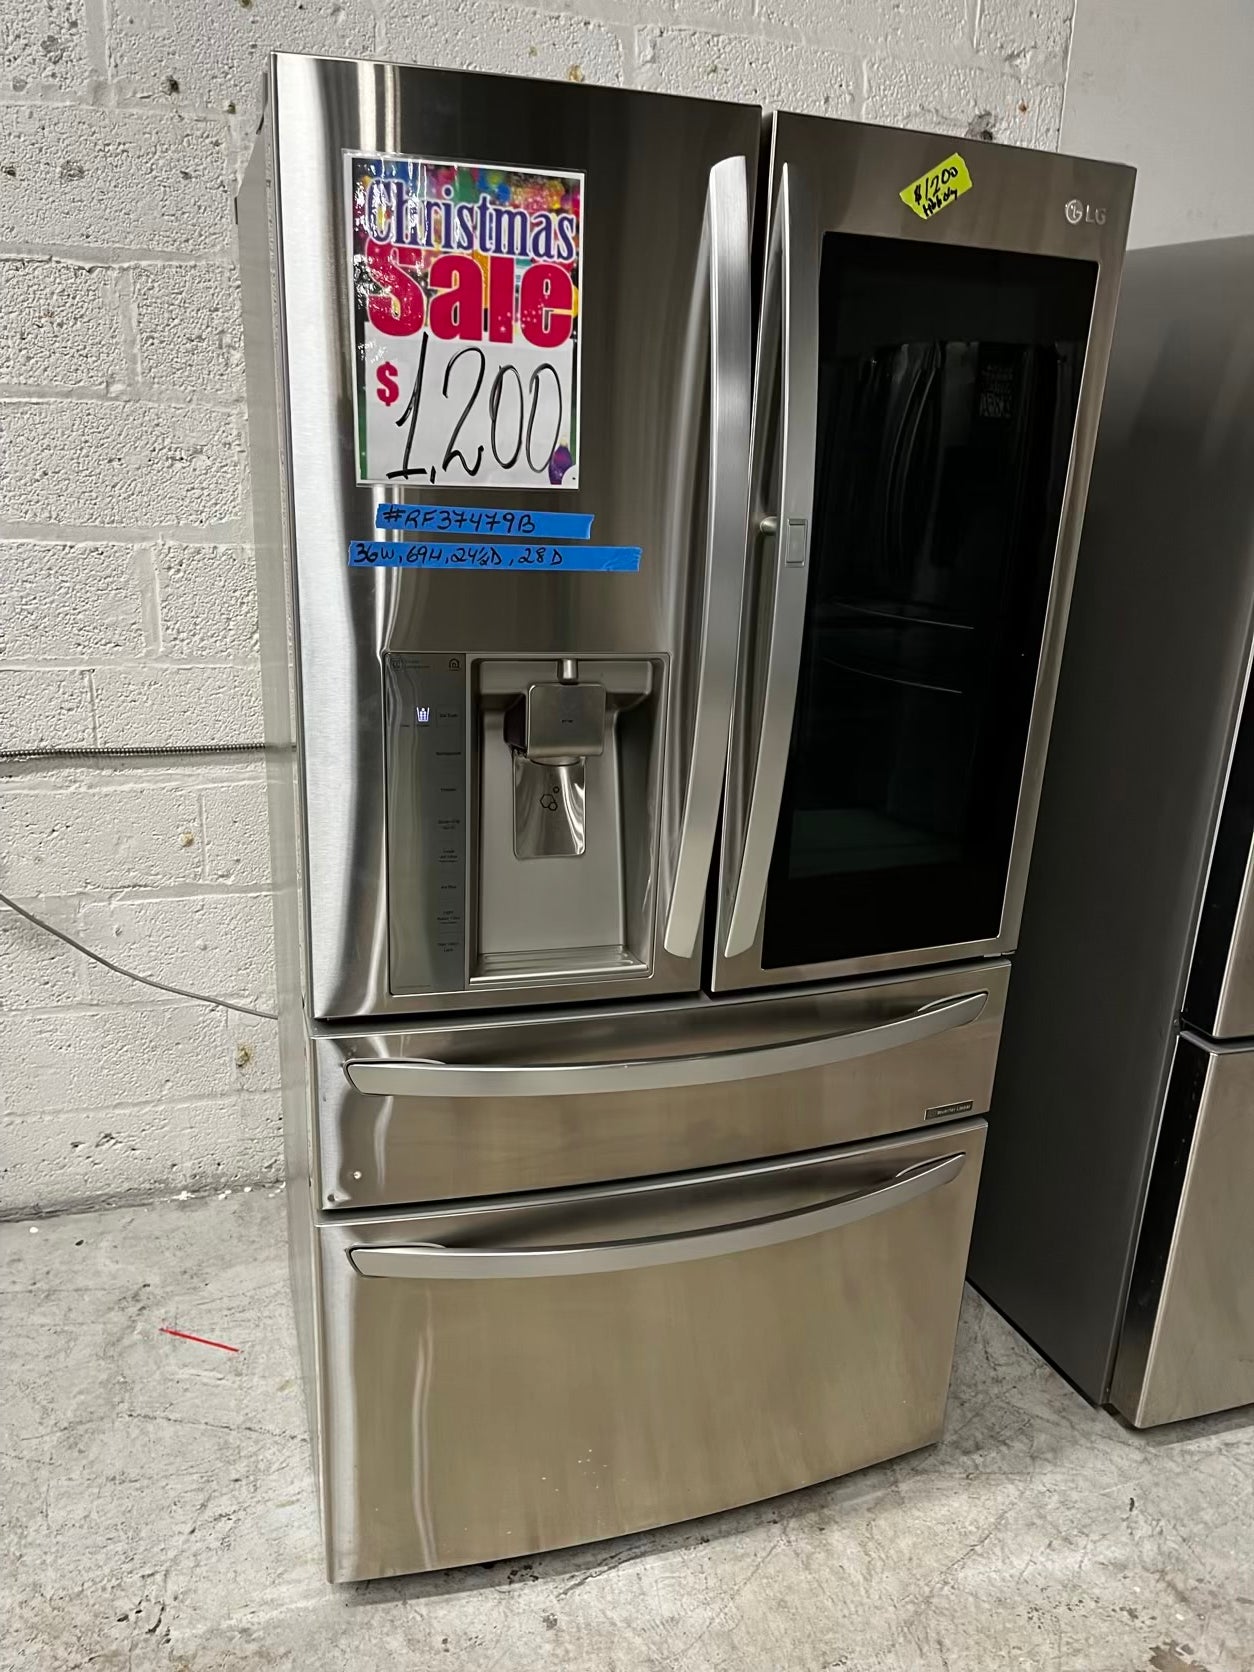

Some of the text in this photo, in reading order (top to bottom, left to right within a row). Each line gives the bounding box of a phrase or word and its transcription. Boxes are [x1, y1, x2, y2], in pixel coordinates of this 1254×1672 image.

[366, 179, 575, 260] Christmas
[913, 166, 959, 206] $1200
[366, 243, 574, 349] Sale
